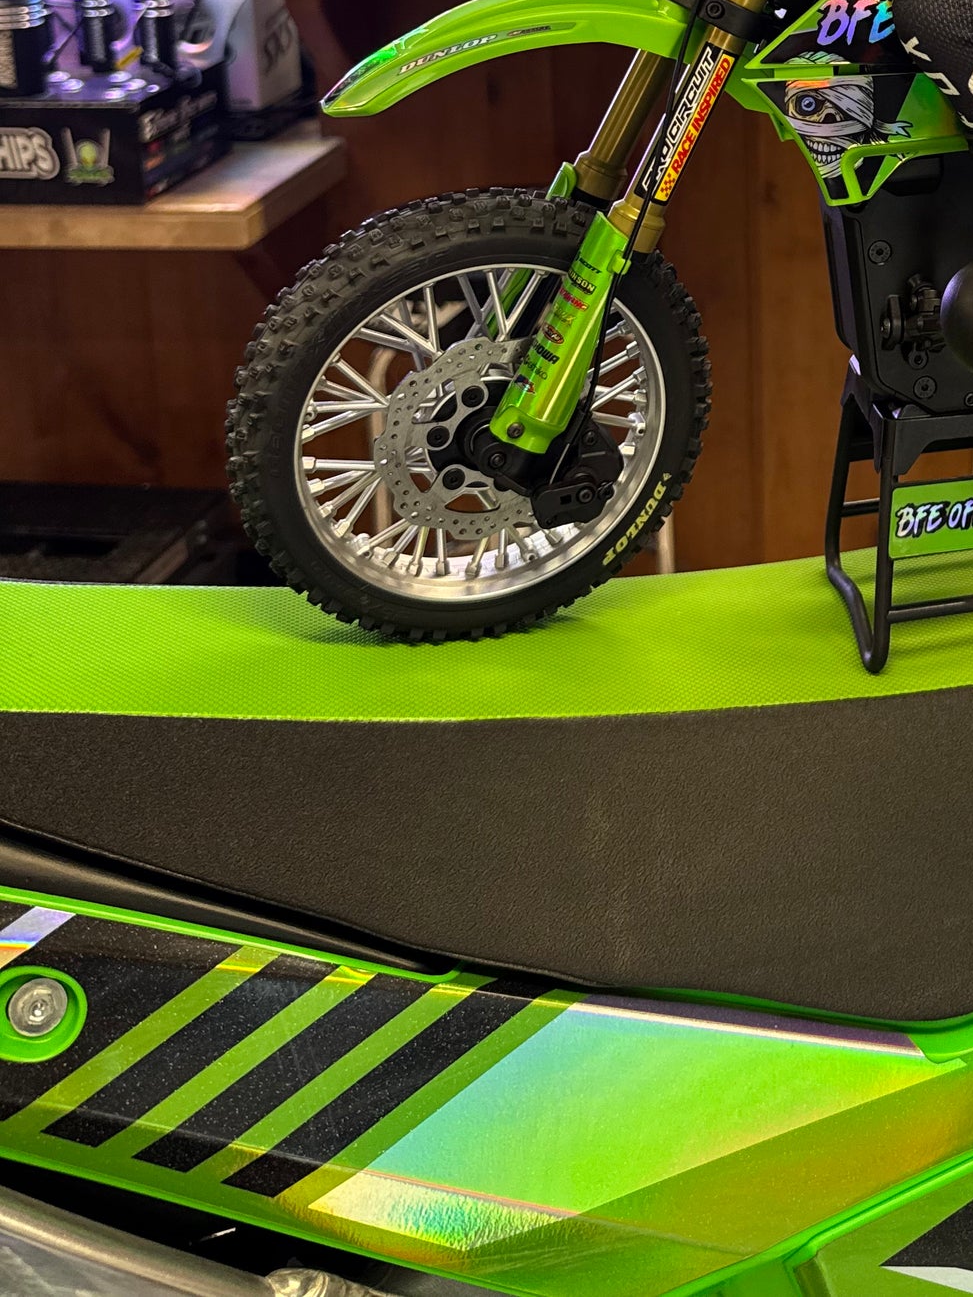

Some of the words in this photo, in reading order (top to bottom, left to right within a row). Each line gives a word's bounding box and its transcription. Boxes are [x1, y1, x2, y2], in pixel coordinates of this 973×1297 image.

[398, 33, 497, 76] DUNLOP
[667, 45, 714, 145] CIRCUIT
[671, 129, 697, 175] RACE
[692, 56, 732, 132] INSPIRED
[602, 481, 668, 566] DUNLOP
[896, 503, 944, 538] BFE
